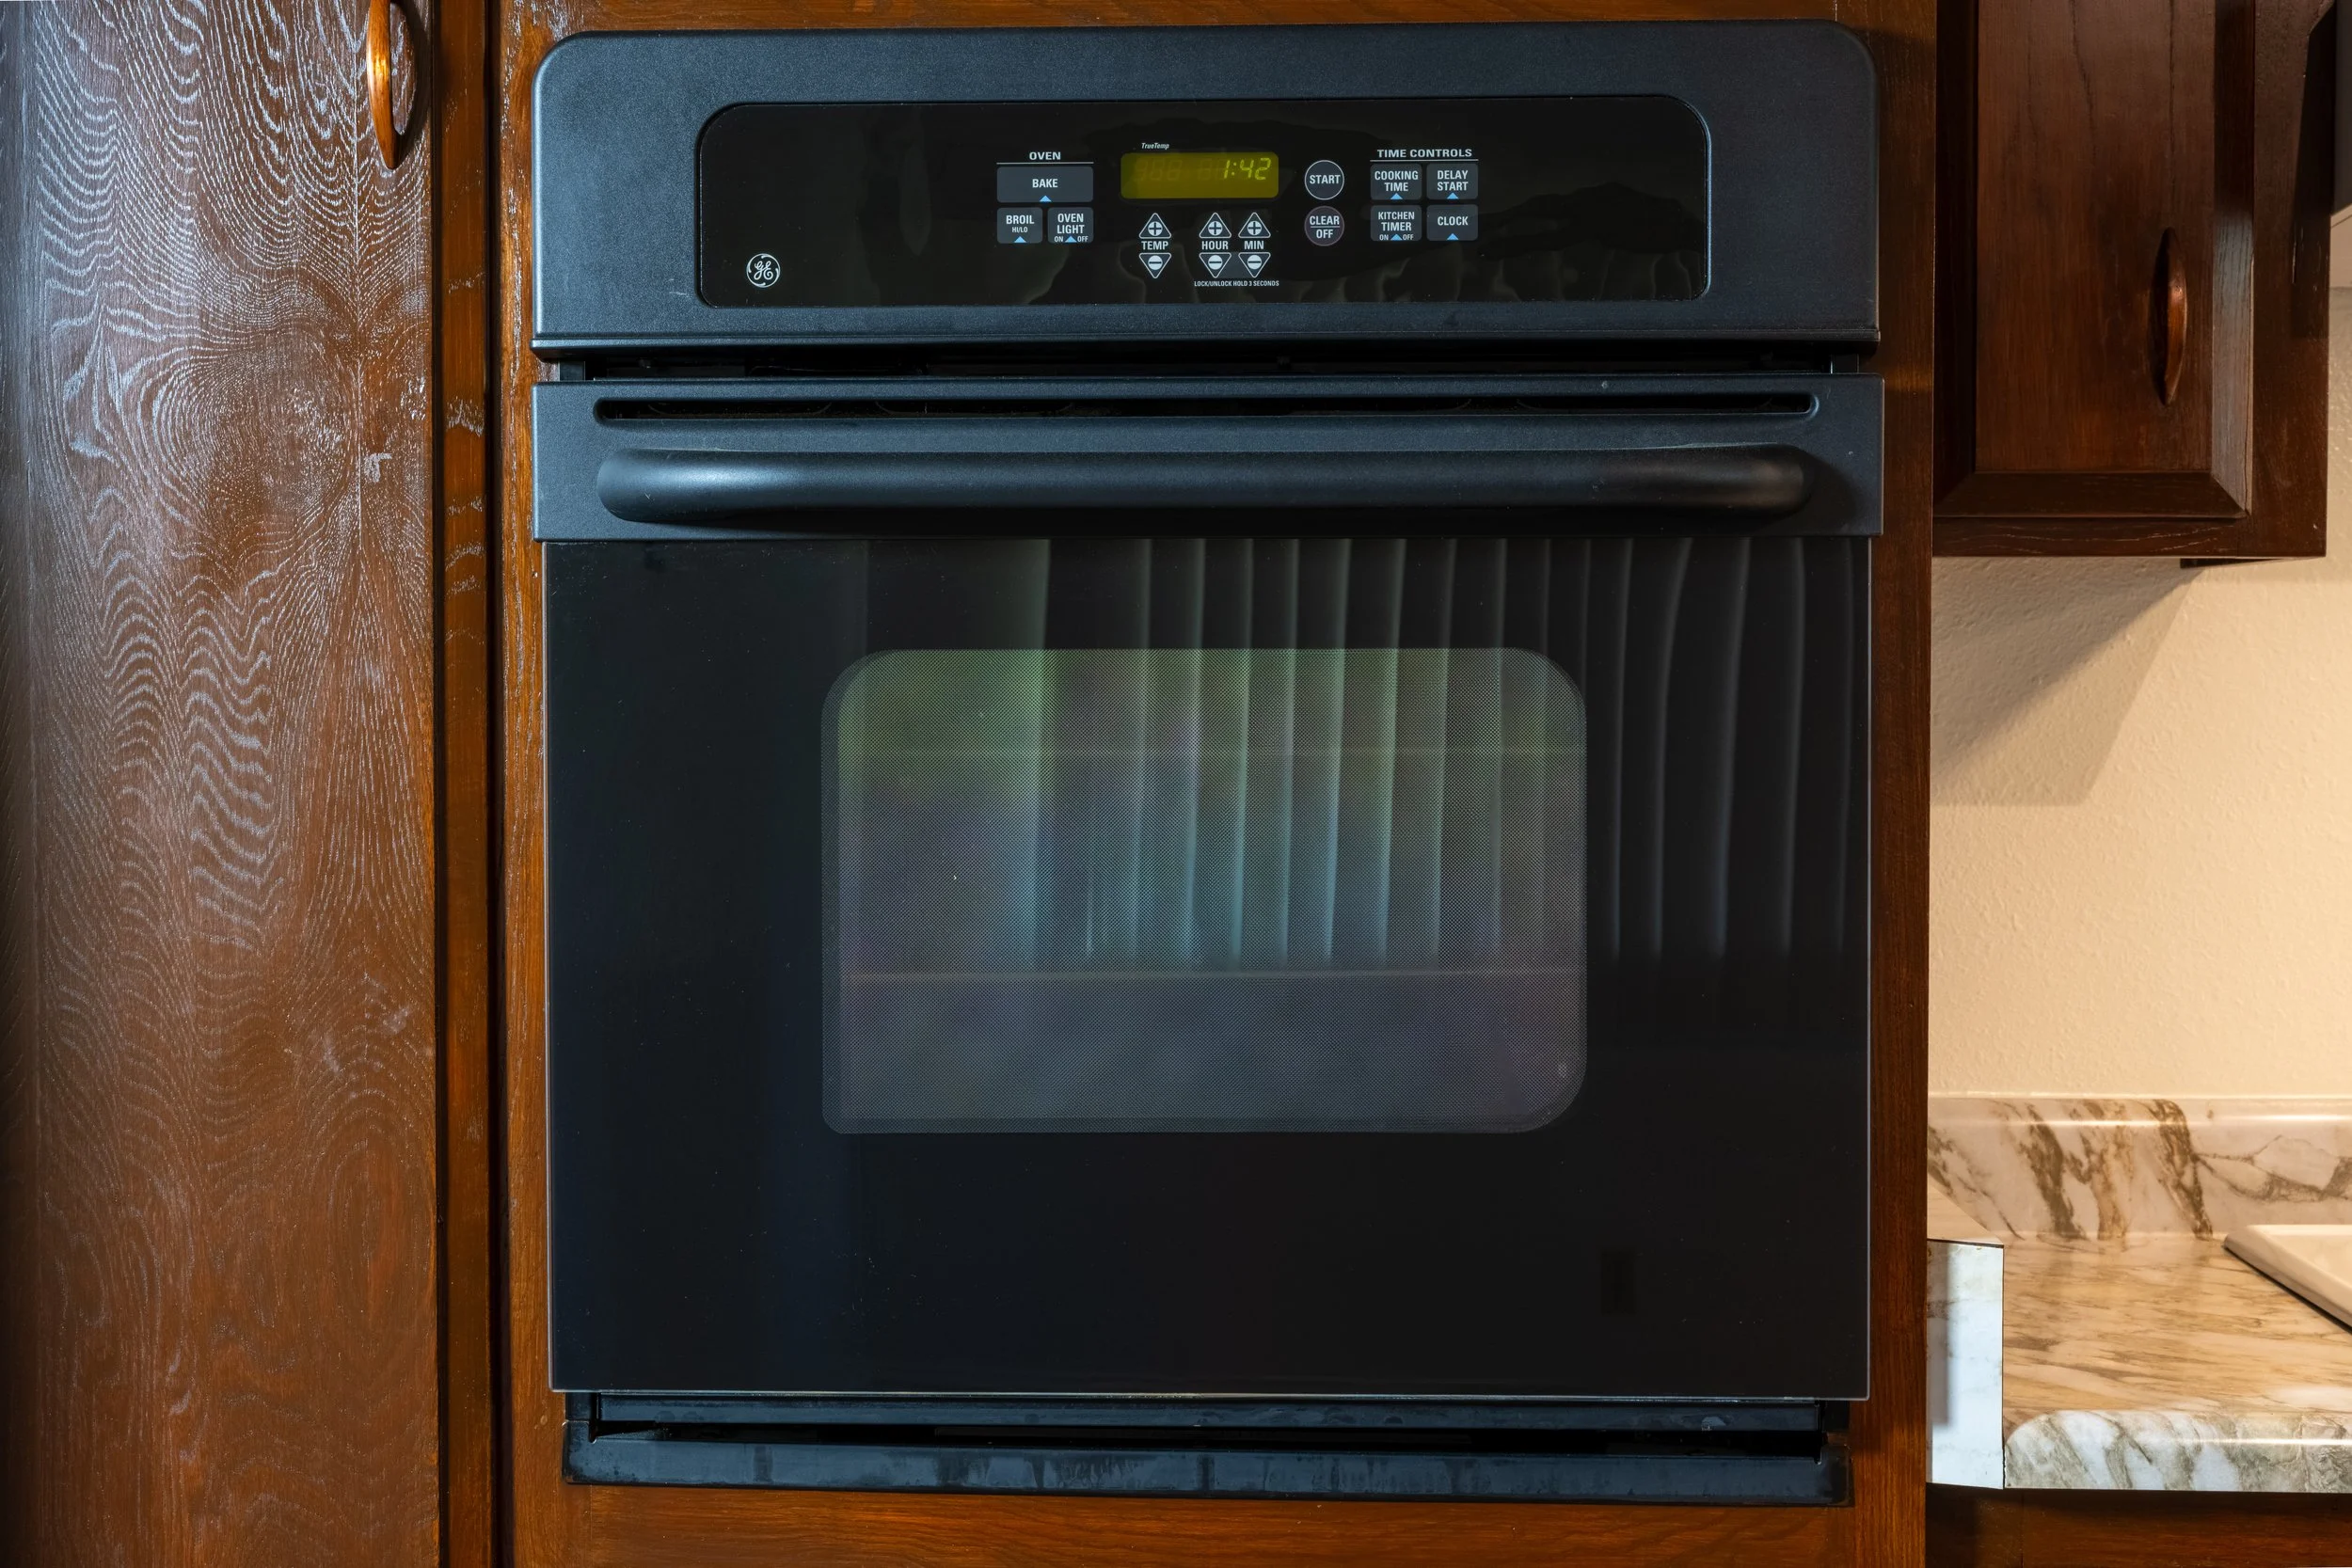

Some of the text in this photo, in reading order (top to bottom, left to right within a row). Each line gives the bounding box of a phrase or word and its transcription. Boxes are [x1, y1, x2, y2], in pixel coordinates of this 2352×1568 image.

[1028, 151, 1061, 161] OVEN
[1376, 148, 1472, 158] TIME CONTROLS
[1223, 157, 1272, 181] 1:42
[1309, 174, 1341, 184] START
[1374, 170, 1419, 181] COOKING
[1437, 169, 1469, 180] DELAY
[1032, 178, 1058, 188] BAKE
[1384, 182, 1409, 192] TIME
[1437, 181, 1469, 191] START
[1006, 214, 1035, 225] BROIL
[1057, 213, 1084, 223] OVEN
[1309, 215, 1340, 226] CLEAR
[1377, 211, 1415, 220] KITCHEN
[1437, 215, 1469, 226] CLOCK
[1057, 224, 1085, 234] LIGHT
[1380, 221, 1412, 231] TIMER
[1315, 229, 1334, 239] OFF
[1140, 240, 1169, 250] TEMP
[1201, 240, 1229, 250] HOUR
[1244, 240, 1264, 250] MIN
